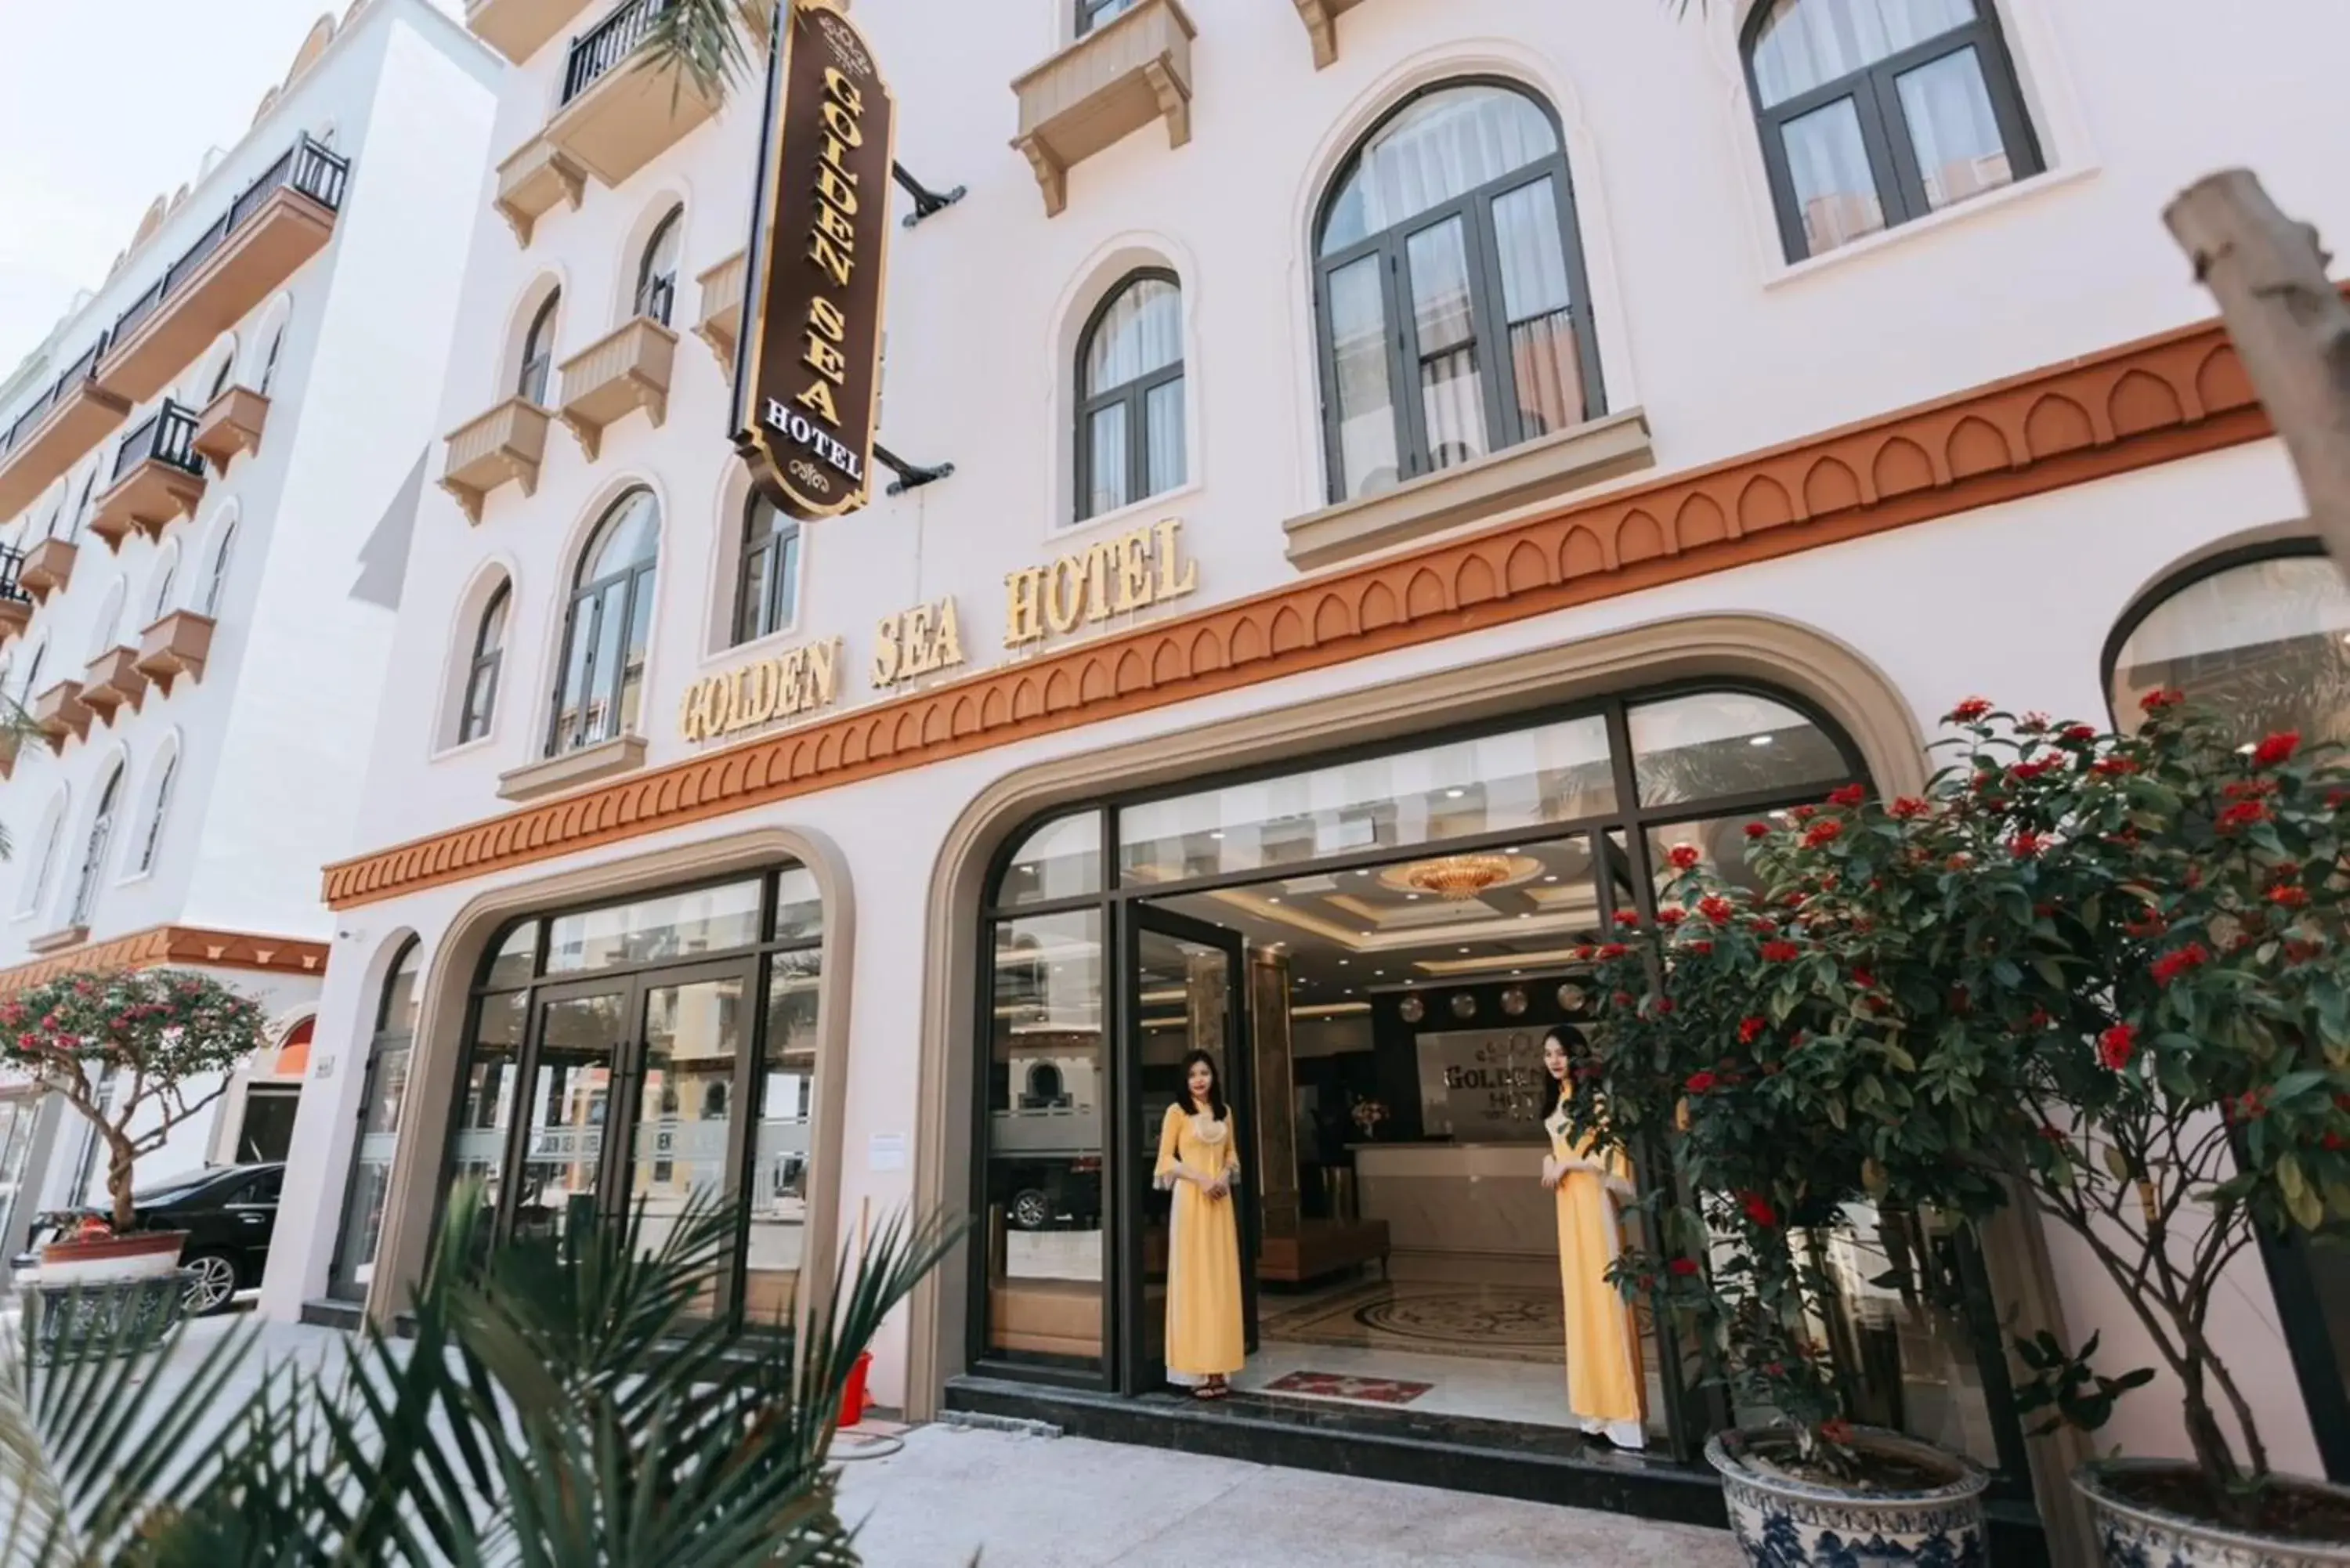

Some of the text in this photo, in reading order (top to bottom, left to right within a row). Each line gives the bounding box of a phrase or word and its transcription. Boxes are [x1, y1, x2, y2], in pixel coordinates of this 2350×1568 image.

[795, 66, 865, 427] GOLDEN SEA
[765, 396, 863, 482] HOTEL
[678, 517, 1198, 742] GOLDEN SEA HOTEL
